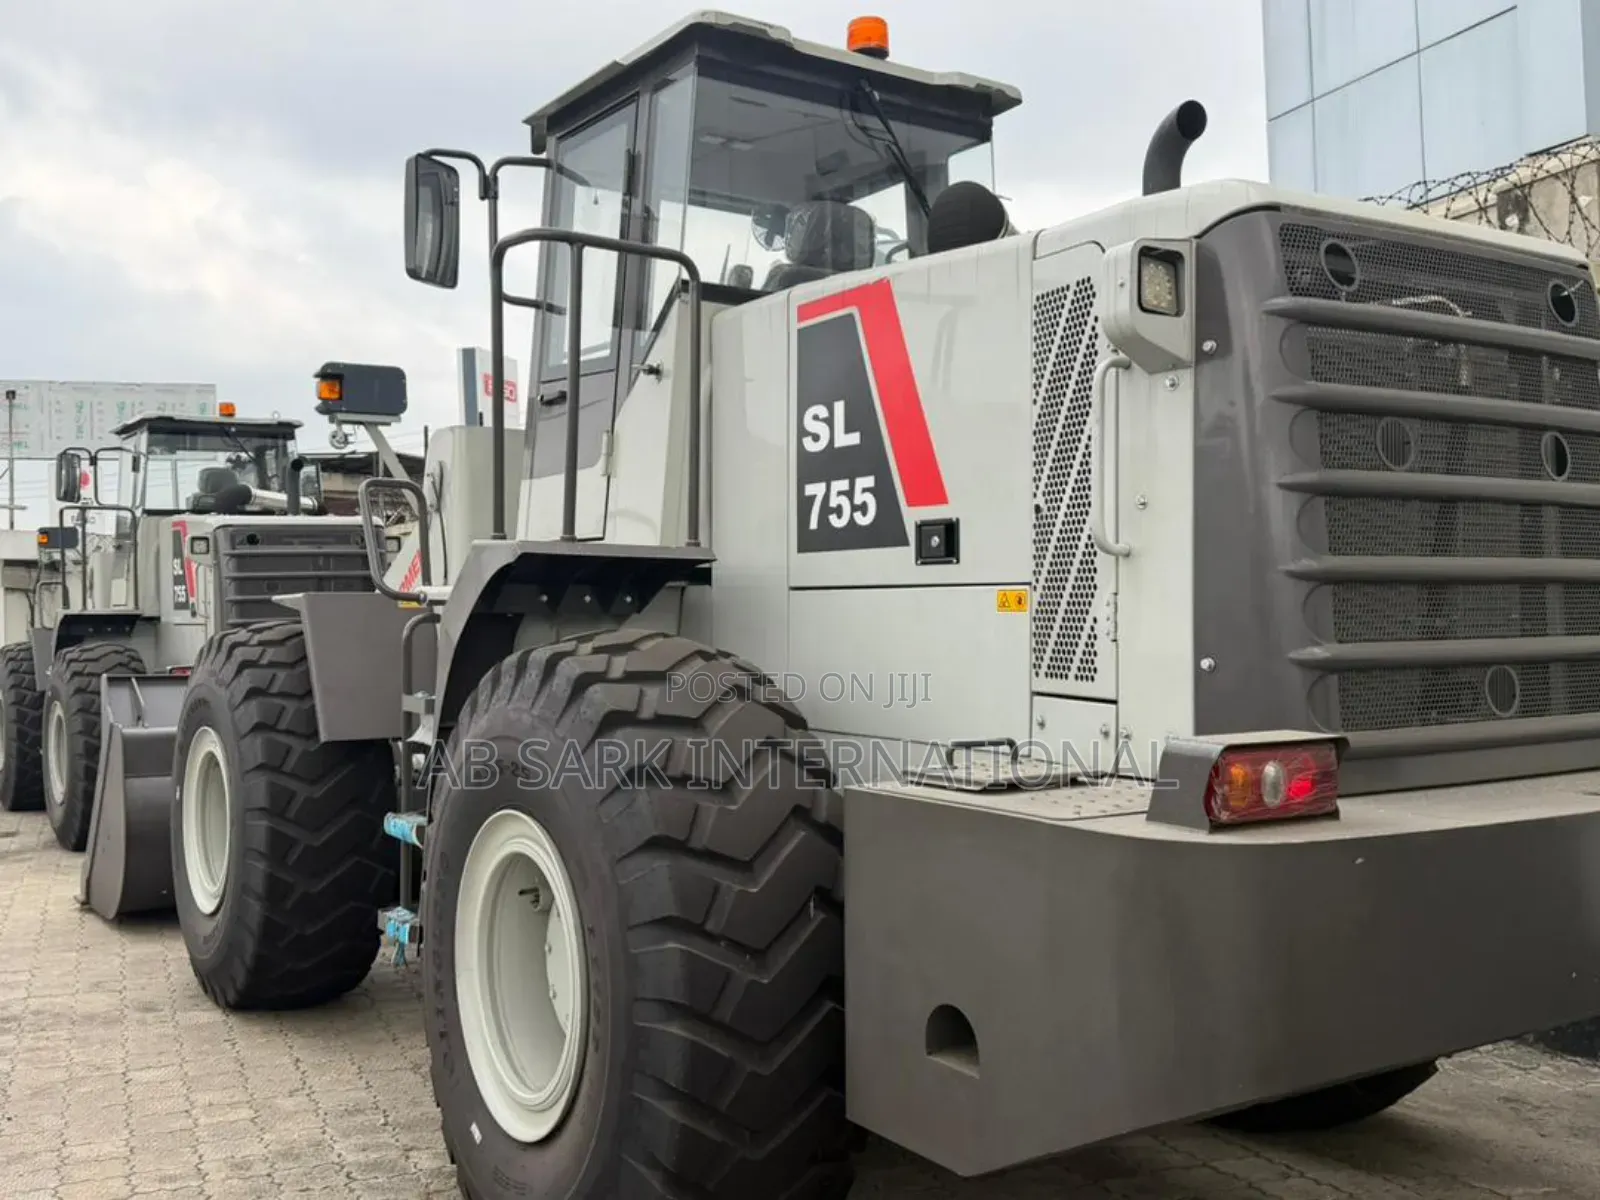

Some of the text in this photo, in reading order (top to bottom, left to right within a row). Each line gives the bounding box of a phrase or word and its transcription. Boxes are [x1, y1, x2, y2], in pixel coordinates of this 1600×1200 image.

[802, 400, 861, 452] SL
[804, 475, 877, 530] 755
[172, 558, 183, 575] SL
[174, 584, 186, 603] 755
